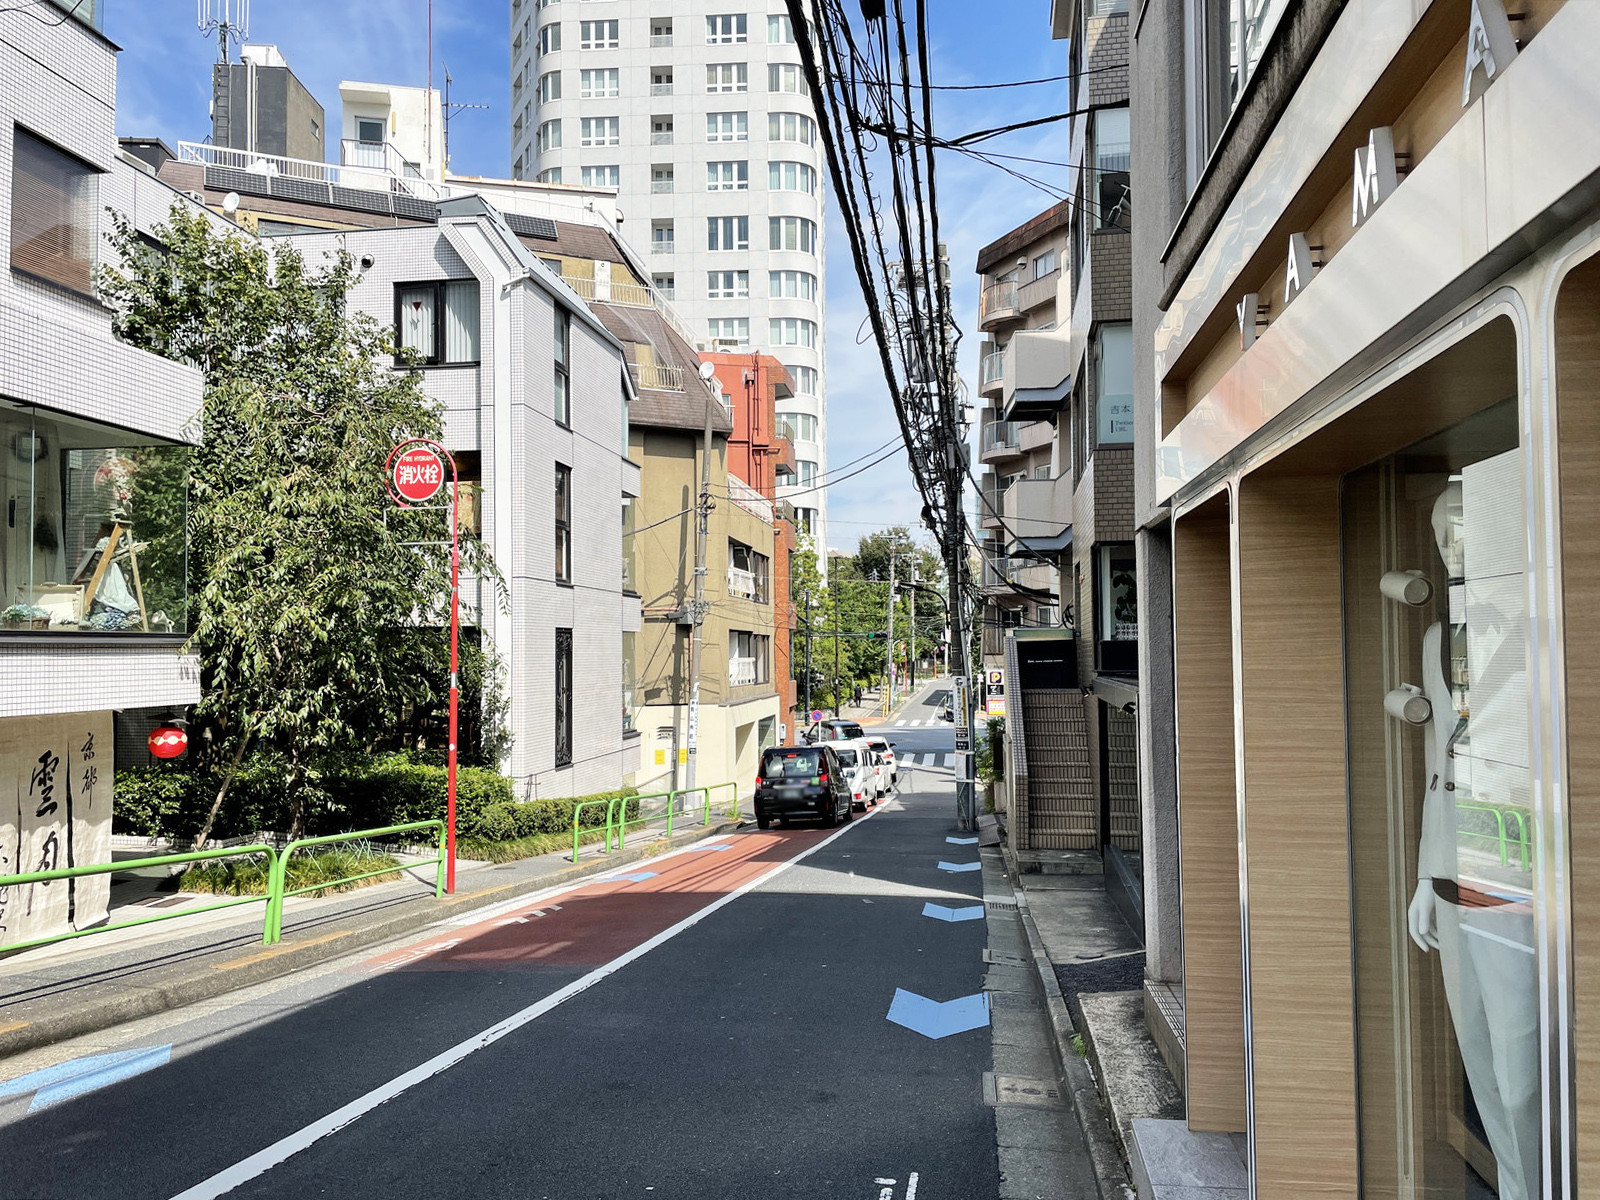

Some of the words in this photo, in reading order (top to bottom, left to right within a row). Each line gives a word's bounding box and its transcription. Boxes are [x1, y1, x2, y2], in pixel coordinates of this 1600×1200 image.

[1110, 405, 1134, 414] 吉本
[399, 464, 439, 485] 消火栓
[81, 732, 98, 810] 京都
